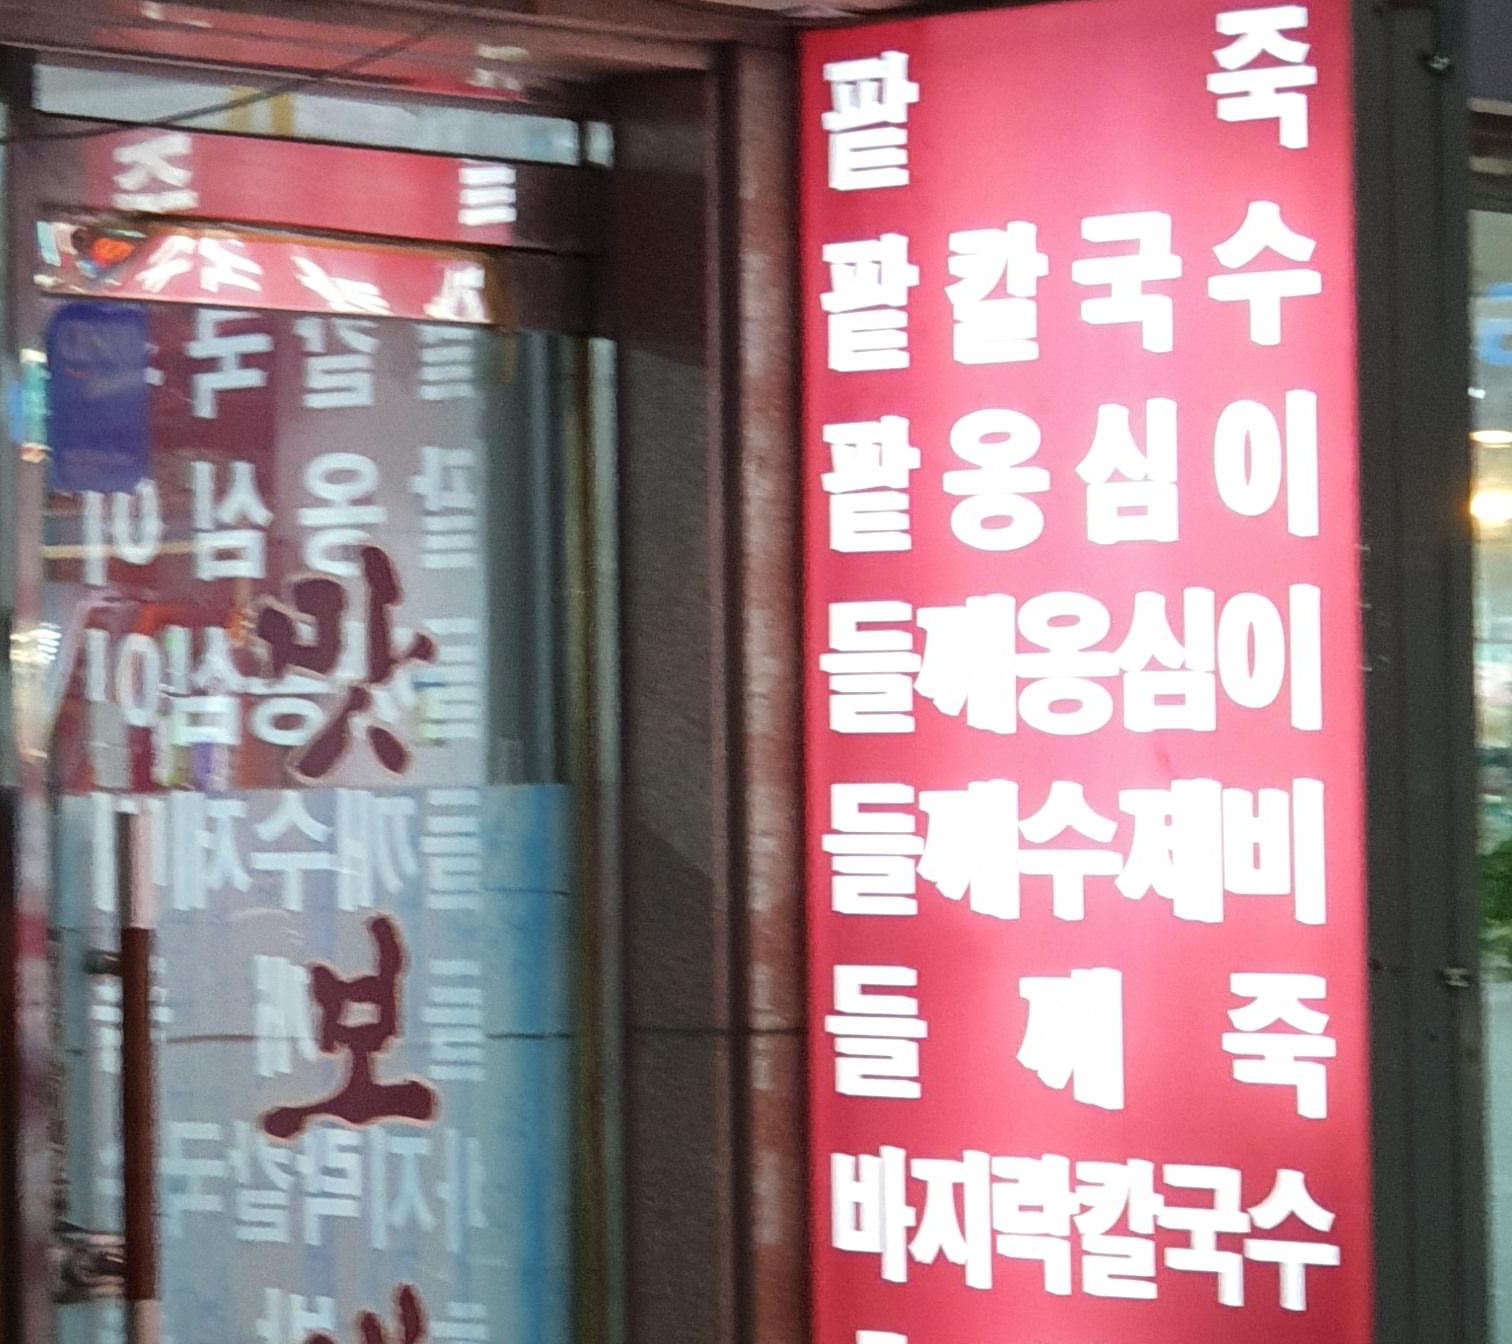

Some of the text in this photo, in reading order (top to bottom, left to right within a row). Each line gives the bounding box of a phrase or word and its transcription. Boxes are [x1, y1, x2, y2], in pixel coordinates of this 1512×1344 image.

[822, 389, 1319, 552] 팥옹심이
[819, 584, 1323, 735] 들깨옹심이
[822, 778, 1326, 925] 들깨수제비
[831, 1146, 1340, 1311] 바지락칼국수
